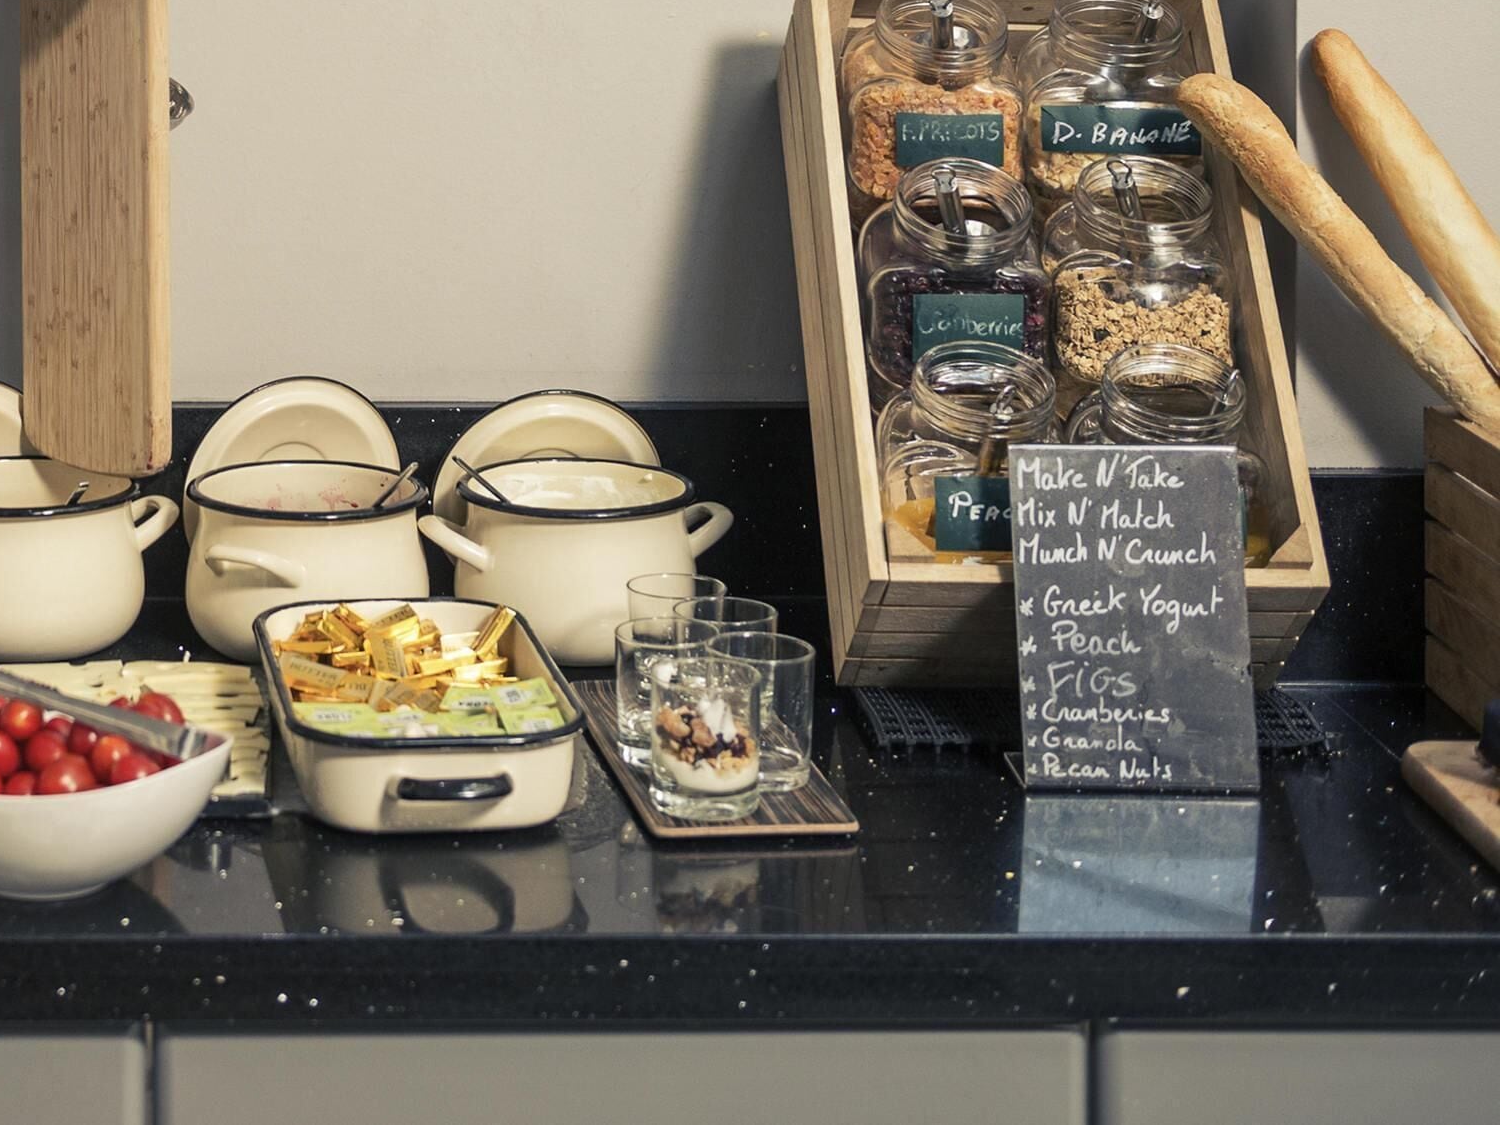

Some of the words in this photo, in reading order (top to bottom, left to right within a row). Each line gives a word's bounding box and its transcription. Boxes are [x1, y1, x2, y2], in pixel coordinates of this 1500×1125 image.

[1017, 457, 1088, 491] Make
[1017, 497, 1056, 528] Mix
[1100, 498, 1175, 530] Match
[1019, 531, 1088, 565] Munch
[1043, 584, 1127, 617] Greek
[1139, 584, 1224, 635] Yogurt
[1051, 620, 1142, 655] Peach
[1042, 724, 1143, 751] Granola
[1042, 752, 1110, 779] Pecan
[1119, 755, 1173, 780] Nuts
